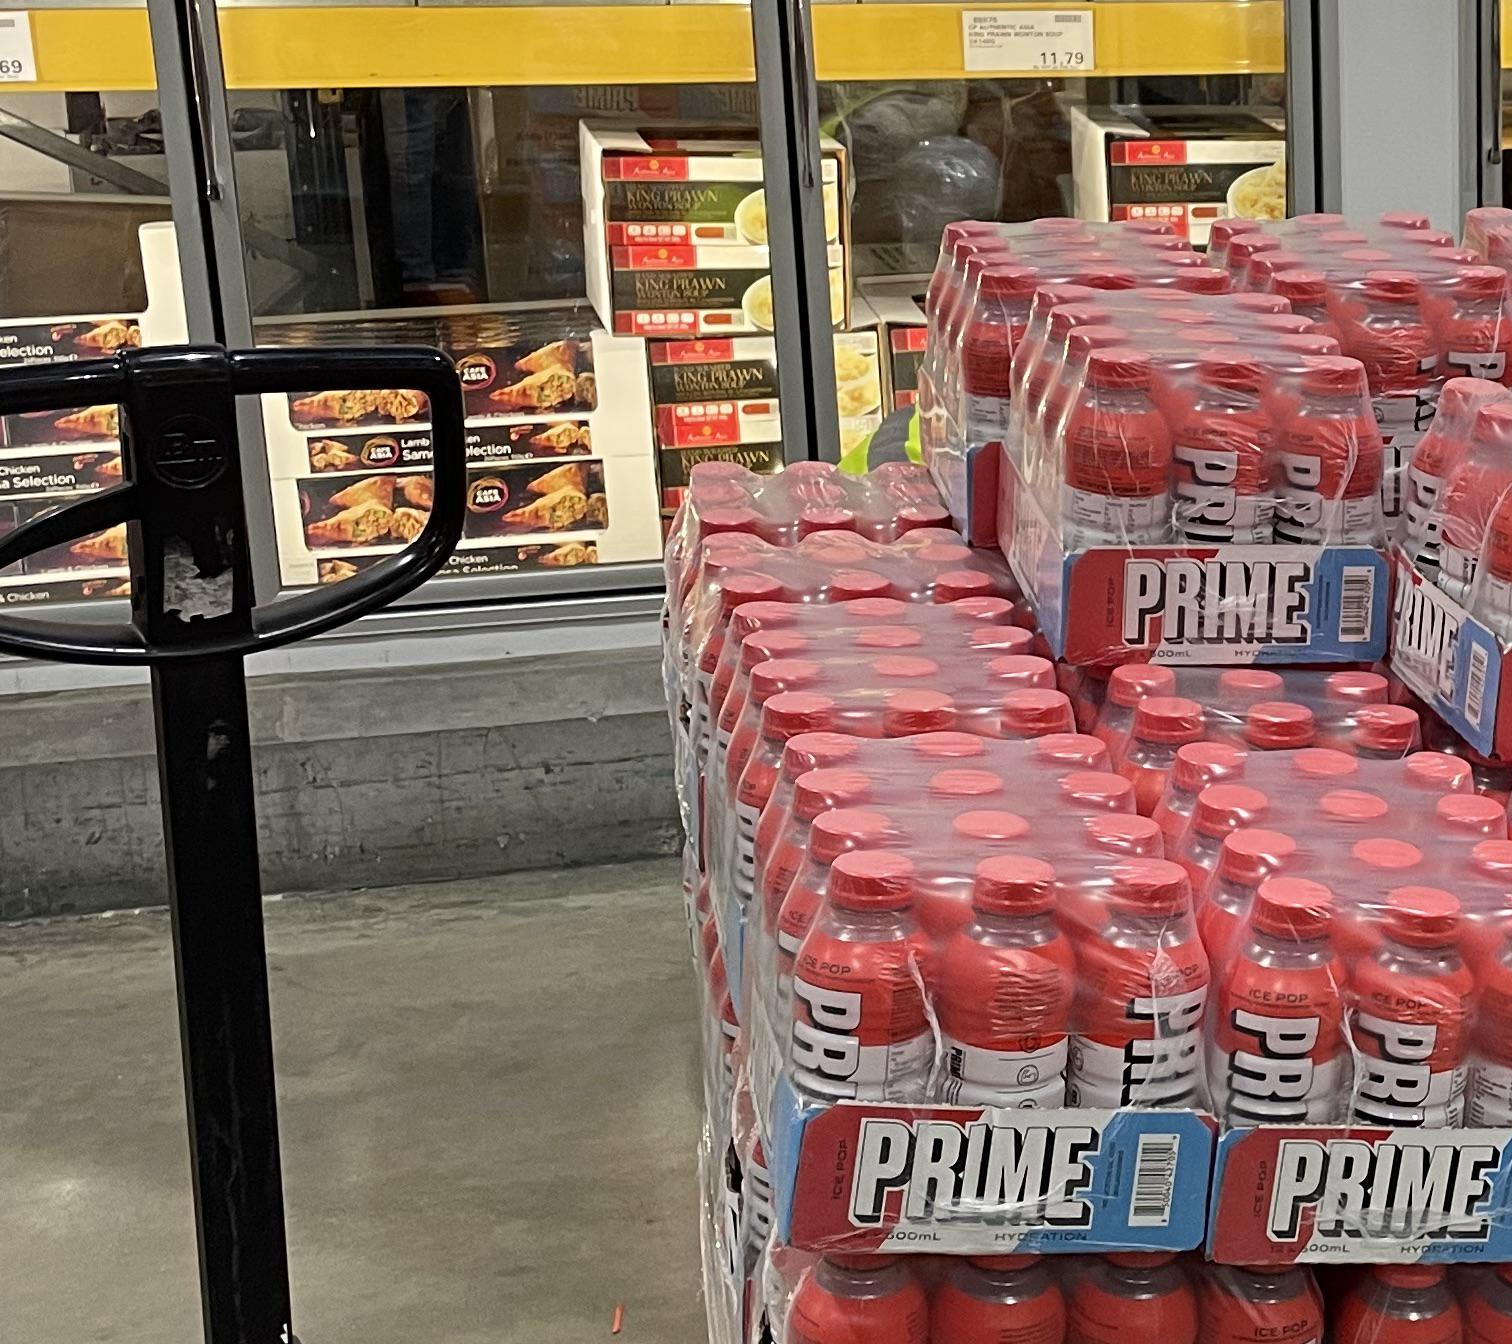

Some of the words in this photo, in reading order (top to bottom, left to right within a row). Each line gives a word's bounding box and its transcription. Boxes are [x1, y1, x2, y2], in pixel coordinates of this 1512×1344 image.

[1040, 52, 1084, 65] 11.79
[664, 189, 719, 203] PRAWN
[635, 278, 669, 290] KING
[672, 277, 727, 290] PRAWN
[674, 368, 707, 382] KING
[401, 438, 430, 448] Lamb
[13, 474, 76, 489] Selection
[449, 554, 489, 565] Chicken
[7, 591, 50, 602] Chicken
[1123, 561, 1311, 645] PRIME
[848, 1116, 1100, 1230] PRIME
[1265, 1136, 1501, 1244] PRIME
